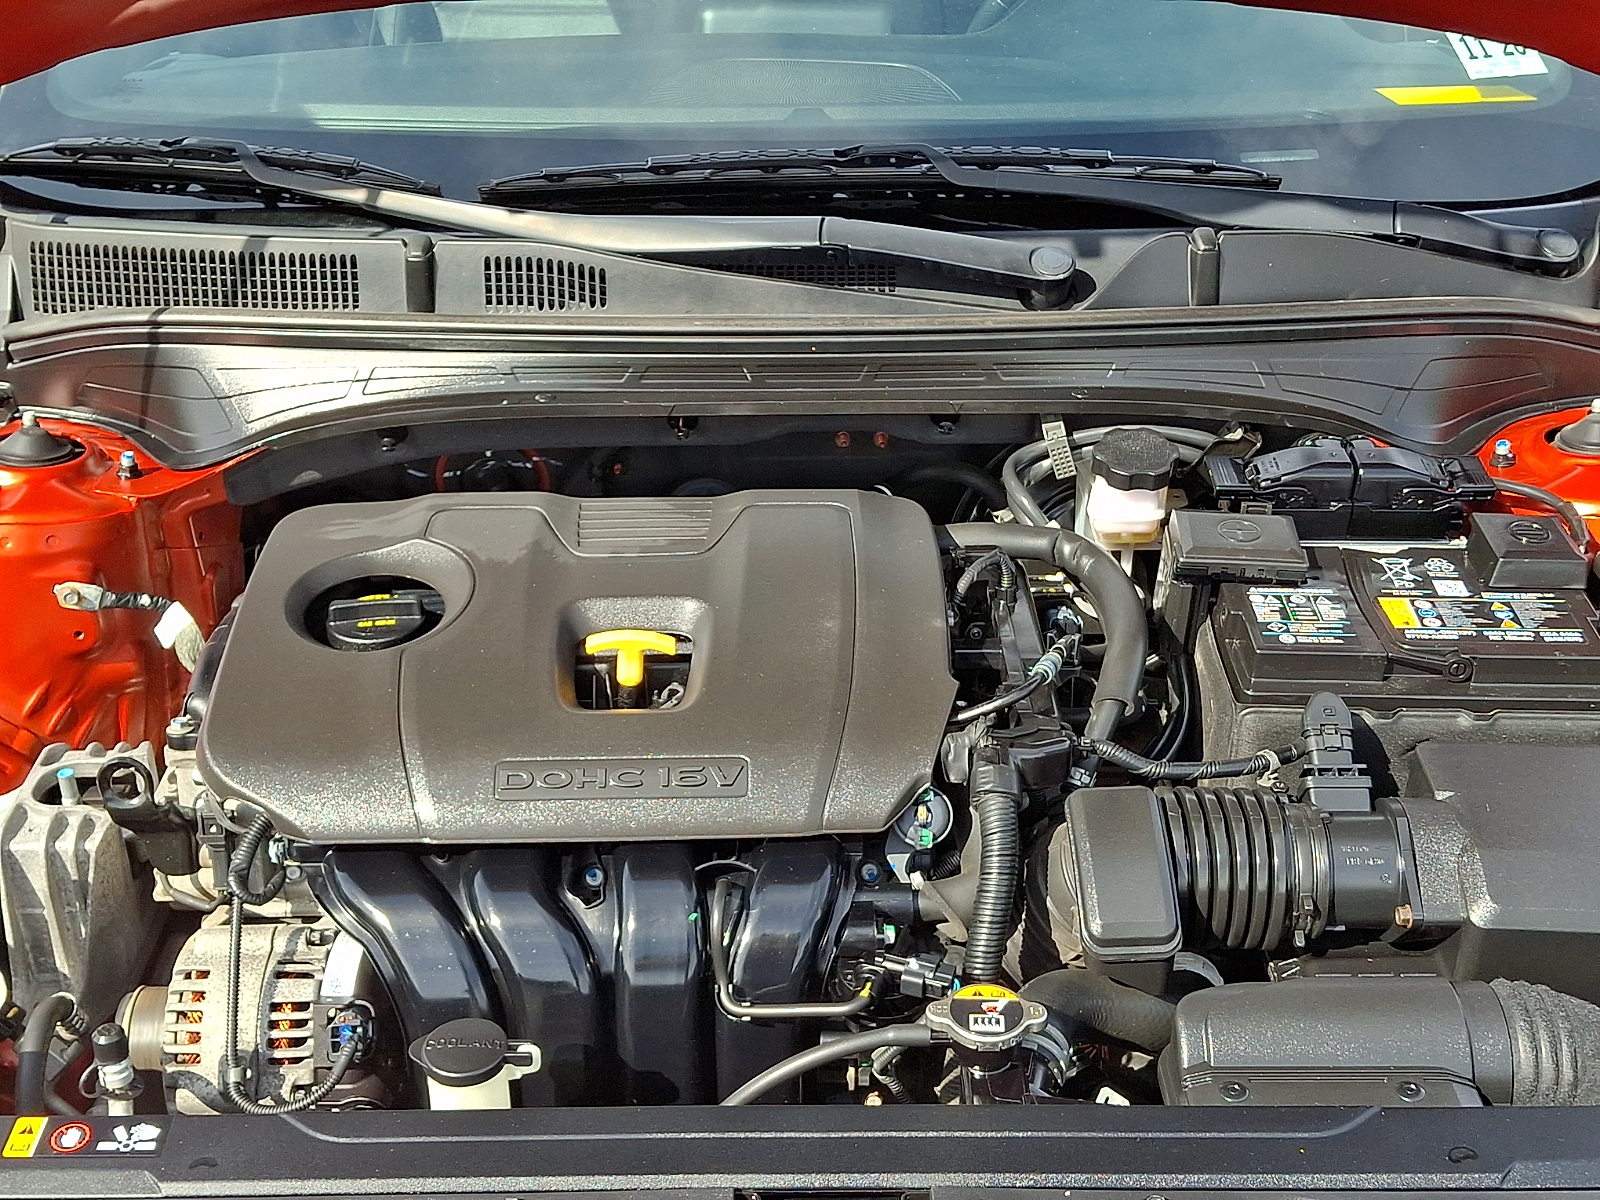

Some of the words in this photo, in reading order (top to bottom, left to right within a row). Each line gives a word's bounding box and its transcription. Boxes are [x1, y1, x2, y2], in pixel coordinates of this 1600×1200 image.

[1394, 580, 1415, 588] Pb
[498, 767, 645, 790] DOHC
[658, 764, 745, 788] 16V
[426, 1037, 504, 1050] COOLANT
